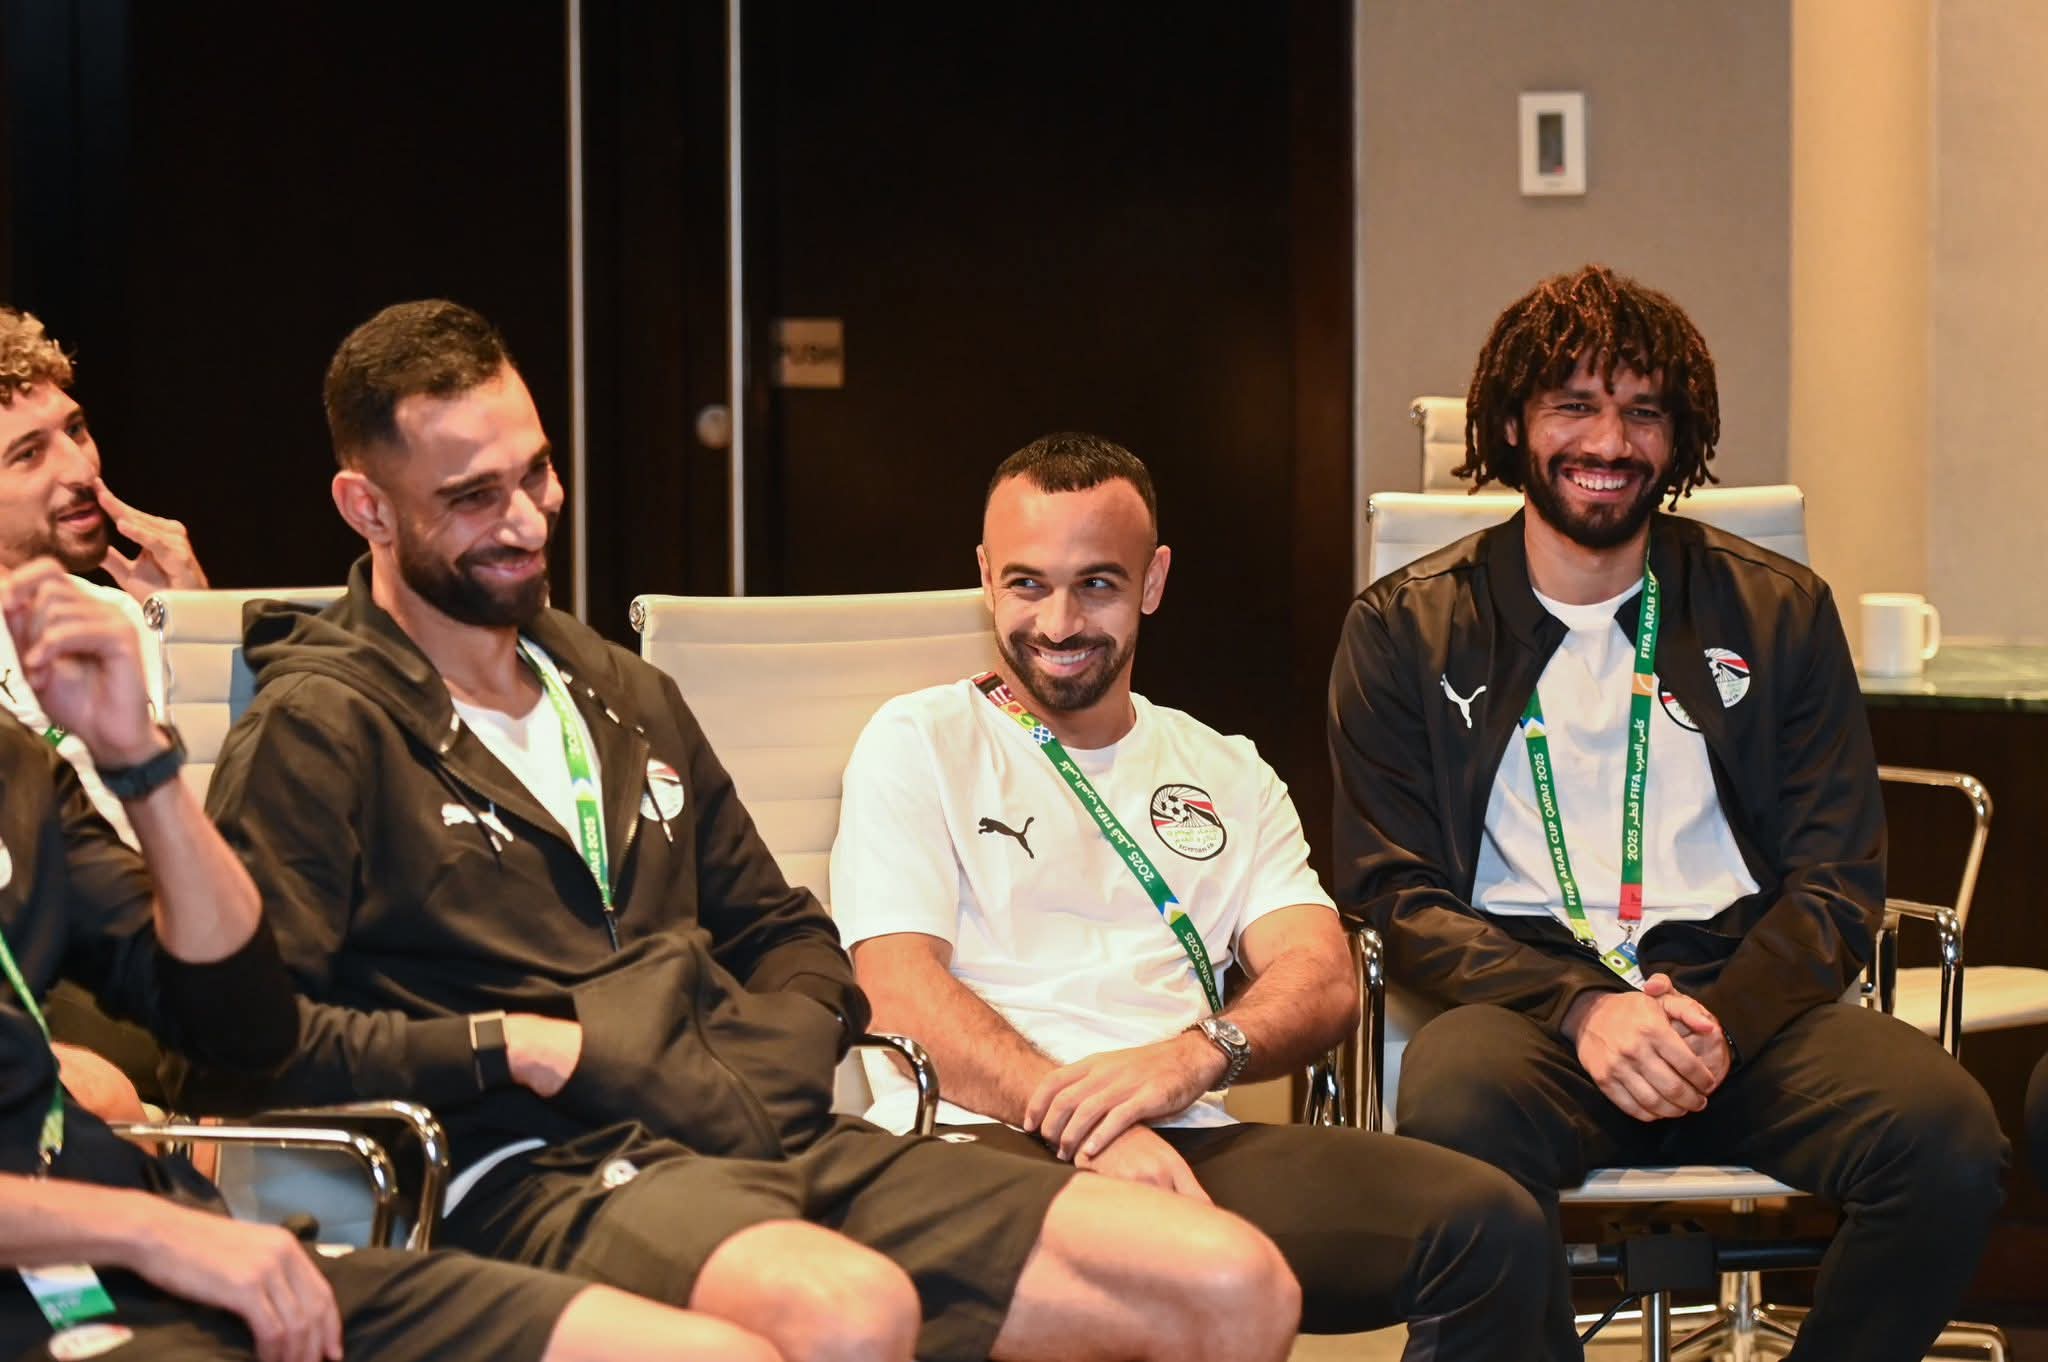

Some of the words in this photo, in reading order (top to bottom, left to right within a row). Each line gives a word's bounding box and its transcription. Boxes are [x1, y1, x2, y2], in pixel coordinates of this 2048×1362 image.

[1648, 571, 1658, 593] CU
[1644, 597, 1656, 629] ARAB
[1640, 633, 1653, 659] FIFA
[1634, 718, 1646, 742] كأس
[1534, 752, 1548, 782] 2025
[1634, 743, 1646, 772] العرب
[1540, 783, 1556, 818] QATAR
[1630, 774, 1642, 799] FIFA
[1059, 760, 1081, 780] كأس
[1074, 780, 1097, 805] العرب
[1095, 805, 1115, 829] FIFA
[1110, 828, 1136, 849] قطر
[1127, 851, 1155, 882] 2025
[1628, 801, 1641, 828] قطر
[1548, 821, 1560, 844] CUP
[1627, 829, 1638, 861] 2025
[1554, 847, 1568, 879] ARAB
[1563, 881, 1577, 906] FIFA
[1183, 931, 1203, 960] 2025
[1199, 960, 1214, 993] QATAR
